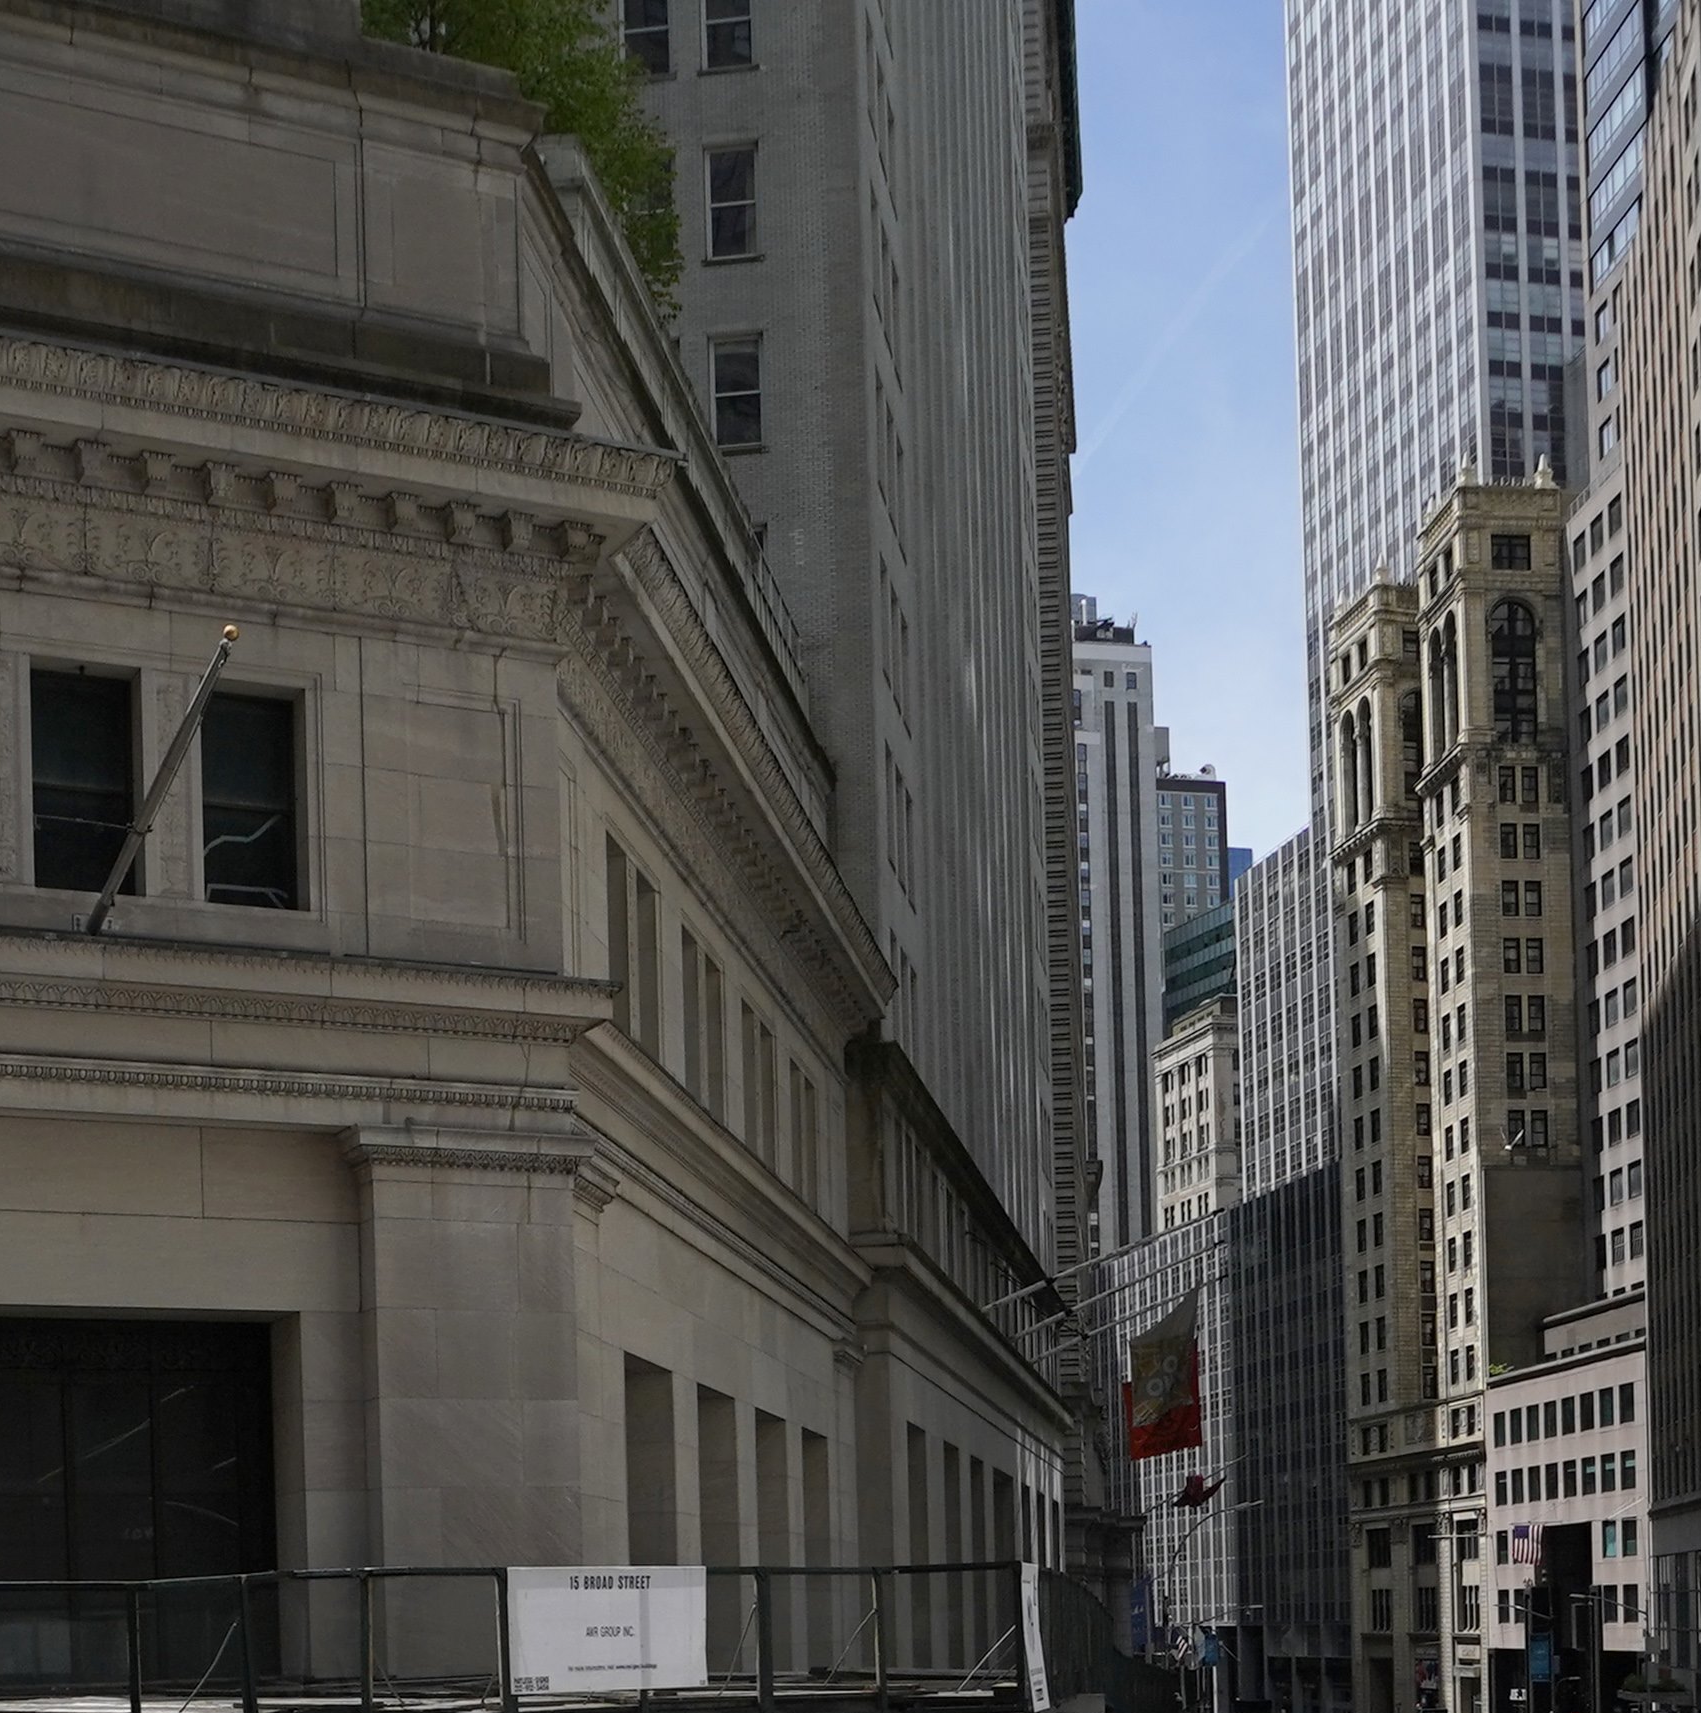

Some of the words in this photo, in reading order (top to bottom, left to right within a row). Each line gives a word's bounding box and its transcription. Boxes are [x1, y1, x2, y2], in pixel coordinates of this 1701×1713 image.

[569, 1575, 580, 1590] 15
[584, 1575, 614, 1590] BROAD
[617, 1575, 651, 1590] STREET
[600, 1625, 621, 1637] GROUP
